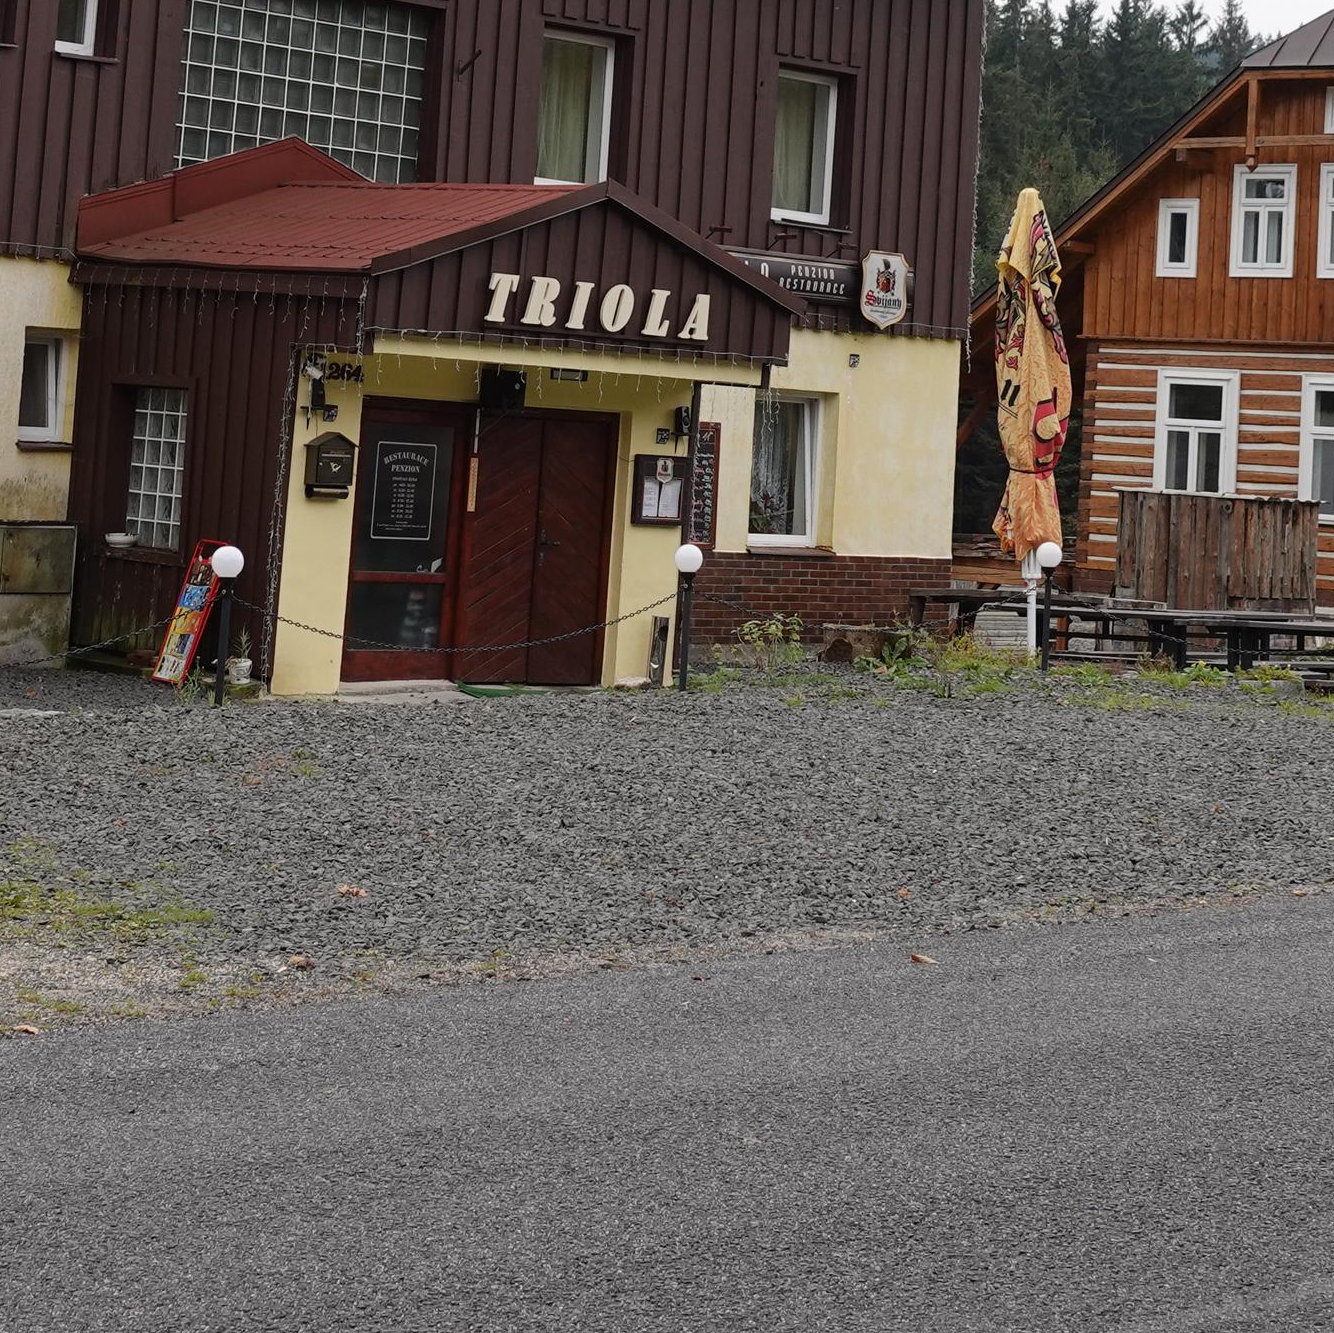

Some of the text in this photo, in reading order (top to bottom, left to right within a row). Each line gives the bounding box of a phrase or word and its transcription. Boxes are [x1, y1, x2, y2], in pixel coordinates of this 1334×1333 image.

[790, 264, 835, 280] PENZION
[778, 277, 846, 295] RESTAURACE
[483, 272, 711, 341] TRIOLA
[864, 289, 902, 310] Svijany
[328, 362, 364, 382] 264
[383, 451, 429, 467] RESTAURACE
[391, 464, 421, 473] PENZION
